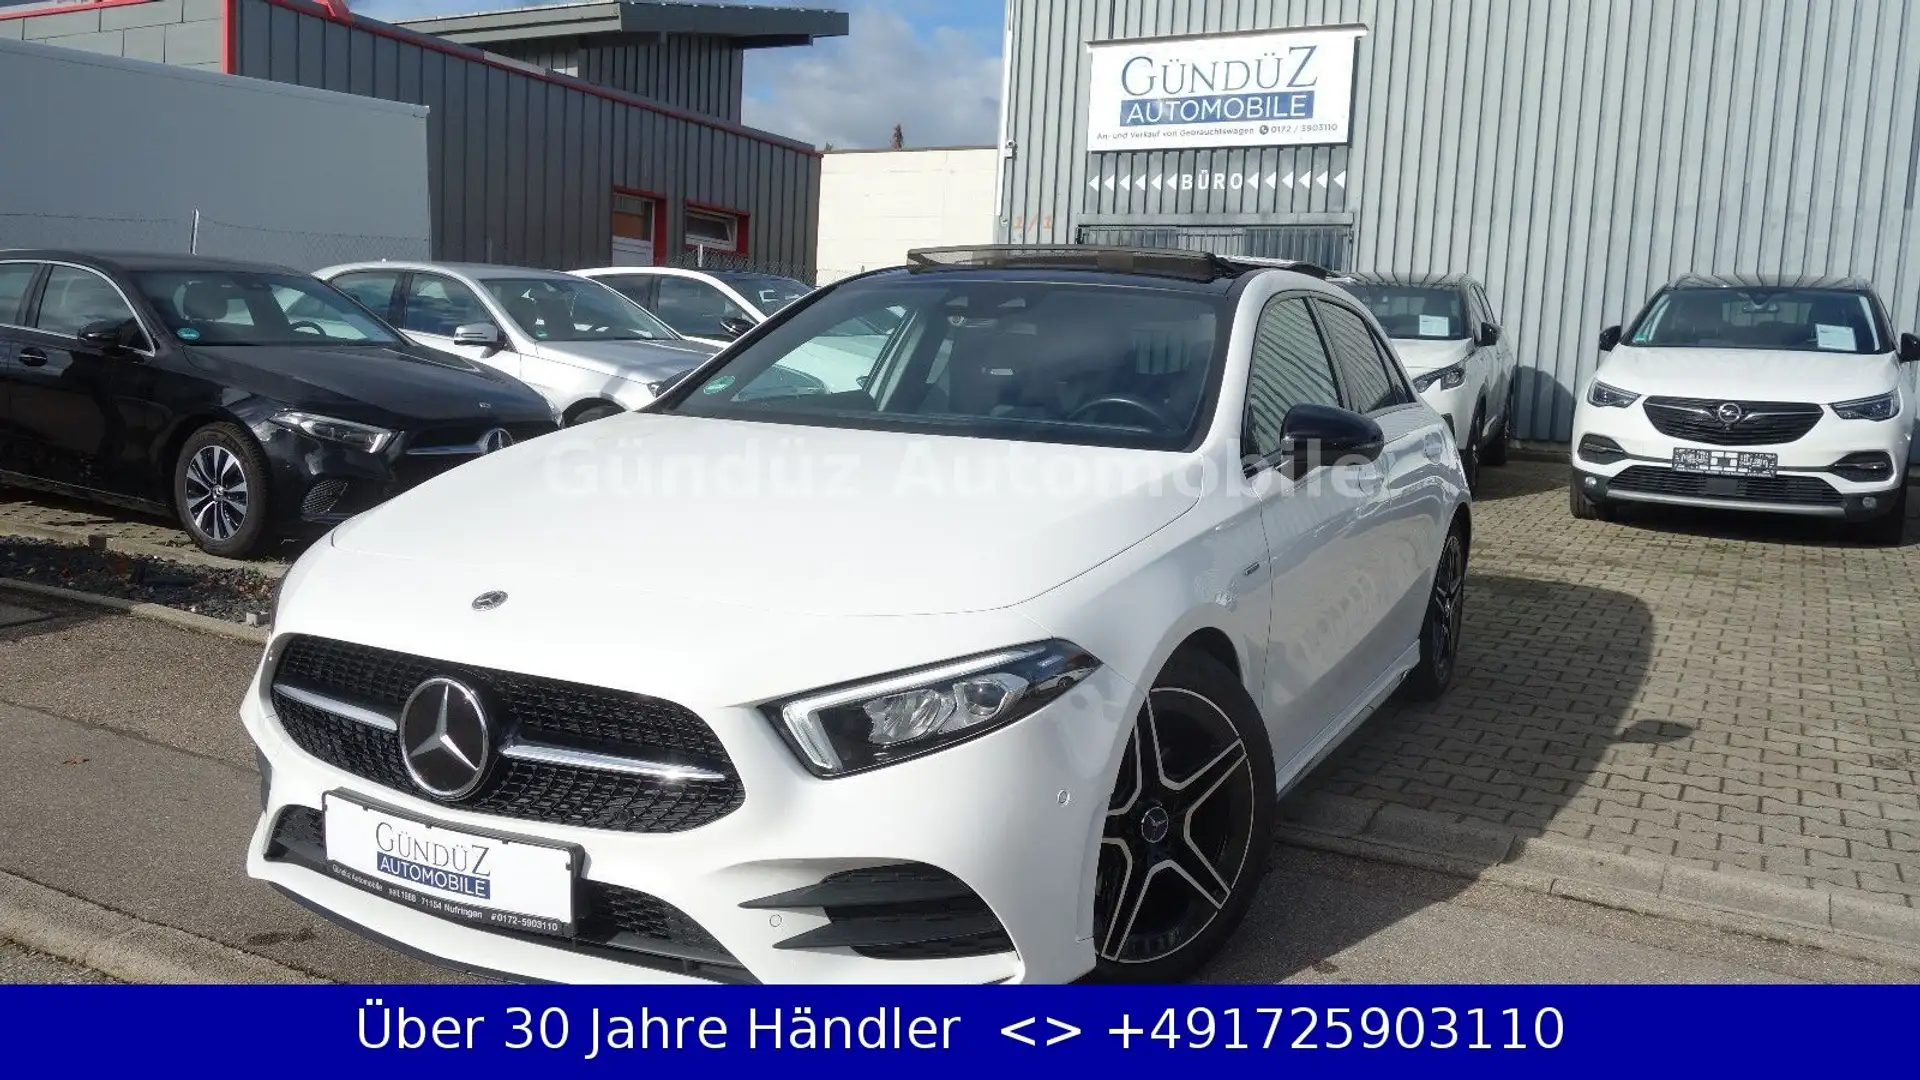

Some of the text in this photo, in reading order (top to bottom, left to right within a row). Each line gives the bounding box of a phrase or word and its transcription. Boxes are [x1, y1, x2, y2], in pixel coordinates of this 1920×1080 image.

[1125, 94, 1307, 124] AUTOMOBILE
[1112, 131, 1128, 140] und
[1130, 130, 1160, 139] Verkauf
[1163, 129, 1178, 138] von
[1179, 126, 1255, 137] Gebrauchtswagen
[1271, 125, 1292, 134] 0172
[1181, 170, 1243, 191] BÜRO
[379, 855, 487, 898] AUTOMOBILE
[421, 896, 442, 910] 71154
[444, 903, 483, 919] Nufringen
[496, 913, 558, 931] 0172-5903110
